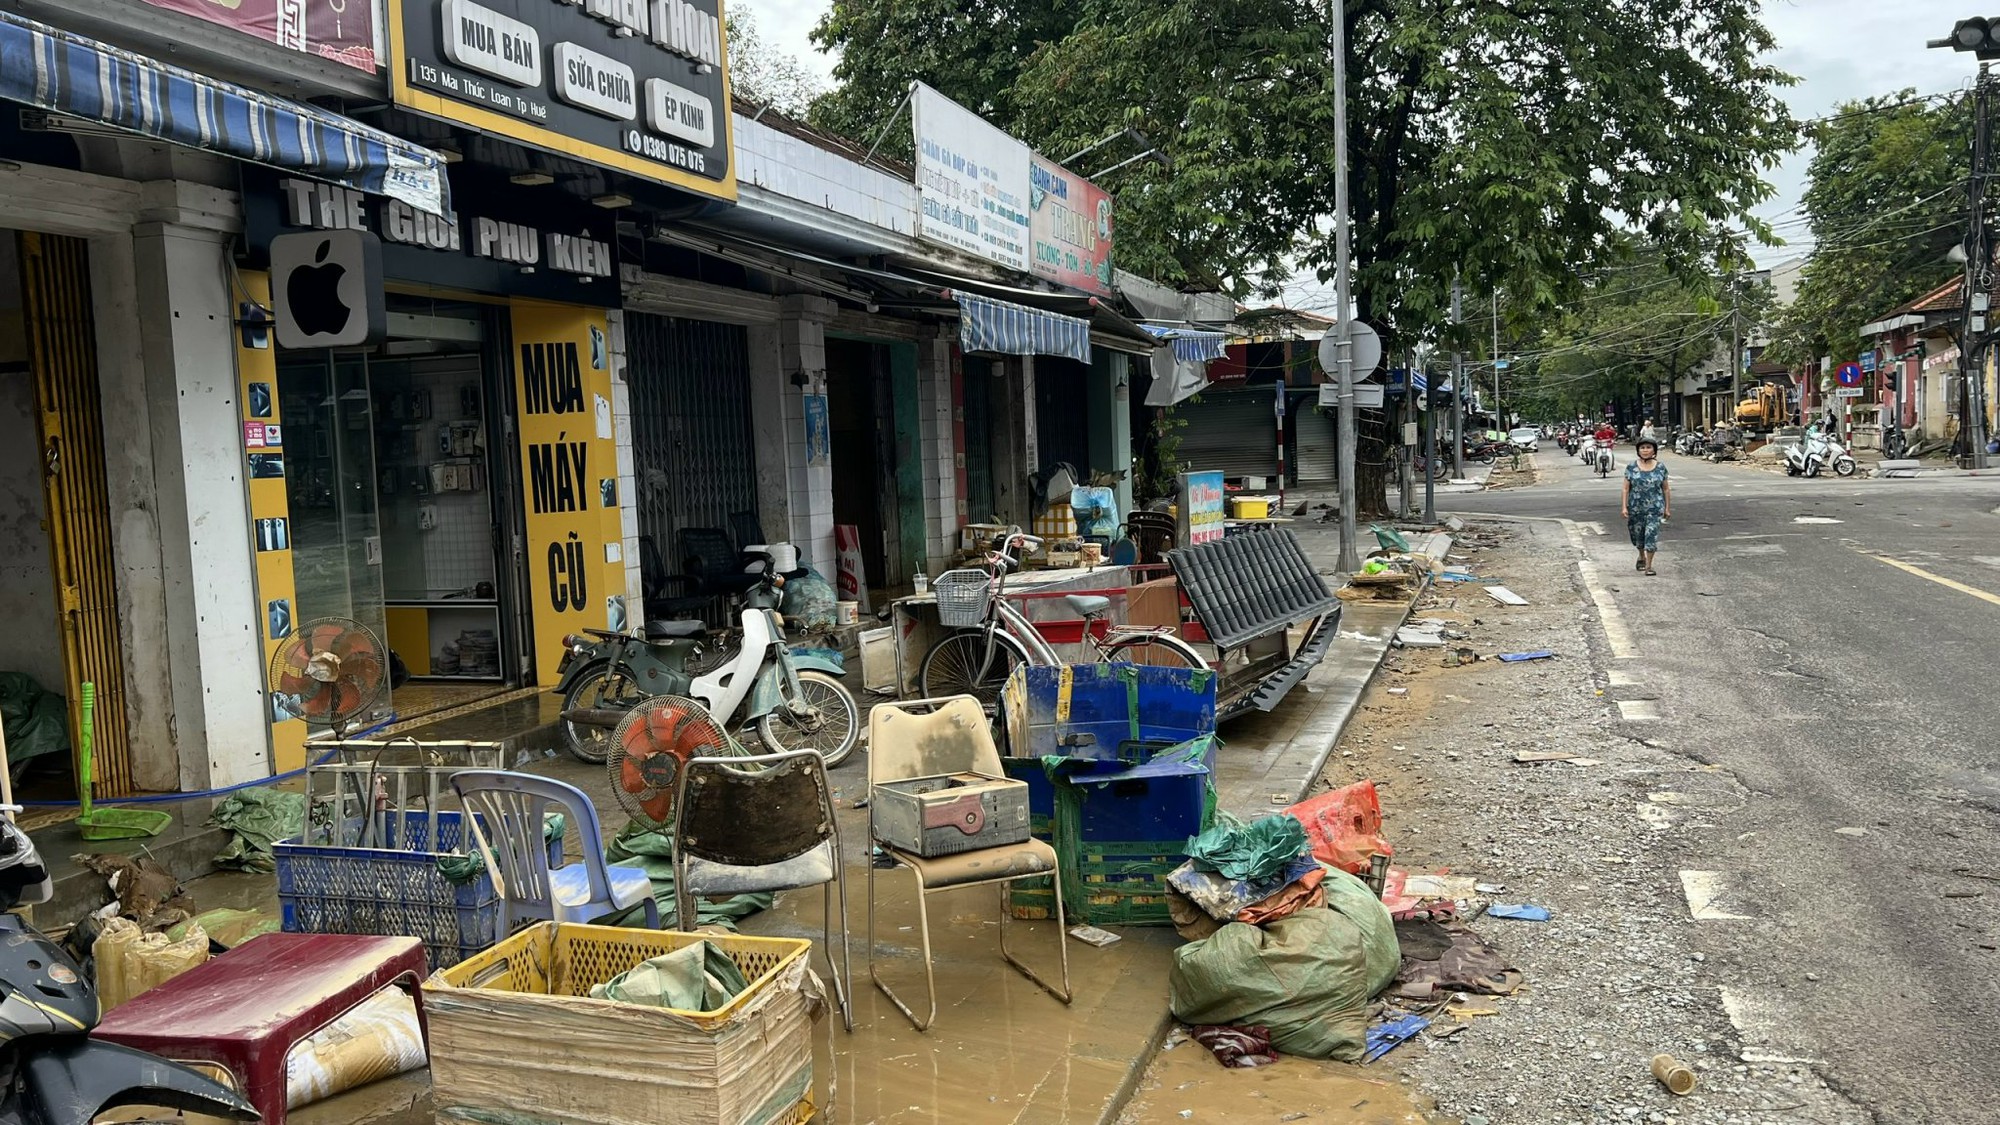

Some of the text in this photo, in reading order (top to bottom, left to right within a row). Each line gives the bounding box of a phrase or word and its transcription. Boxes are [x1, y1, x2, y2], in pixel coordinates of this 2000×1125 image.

[461, 16, 533, 69] MUA BÁN
[420, 64, 436, 83] 135
[441, 71, 459, 90] Mai
[463, 79, 485, 99] Thúc
[490, 87, 511, 108] Loan
[516, 97, 526, 115] Tp
[568, 55, 632, 105] SỬA CHỮA
[664, 91, 704, 131] ÉP KÍNH
[643, 135, 705, 173] 0389 075 075
[1033, 165, 1051, 193] BÁNH
[1051, 174, 1067, 200] CANH
[472, 216, 539, 273] PHỤ
[546, 228, 611, 283] KIỆN
[1051, 202, 1095, 252] TRANG
[521, 342, 585, 414] MUA
[528, 431, 587, 514] MÁY
[547, 530, 587, 613] CŨ
